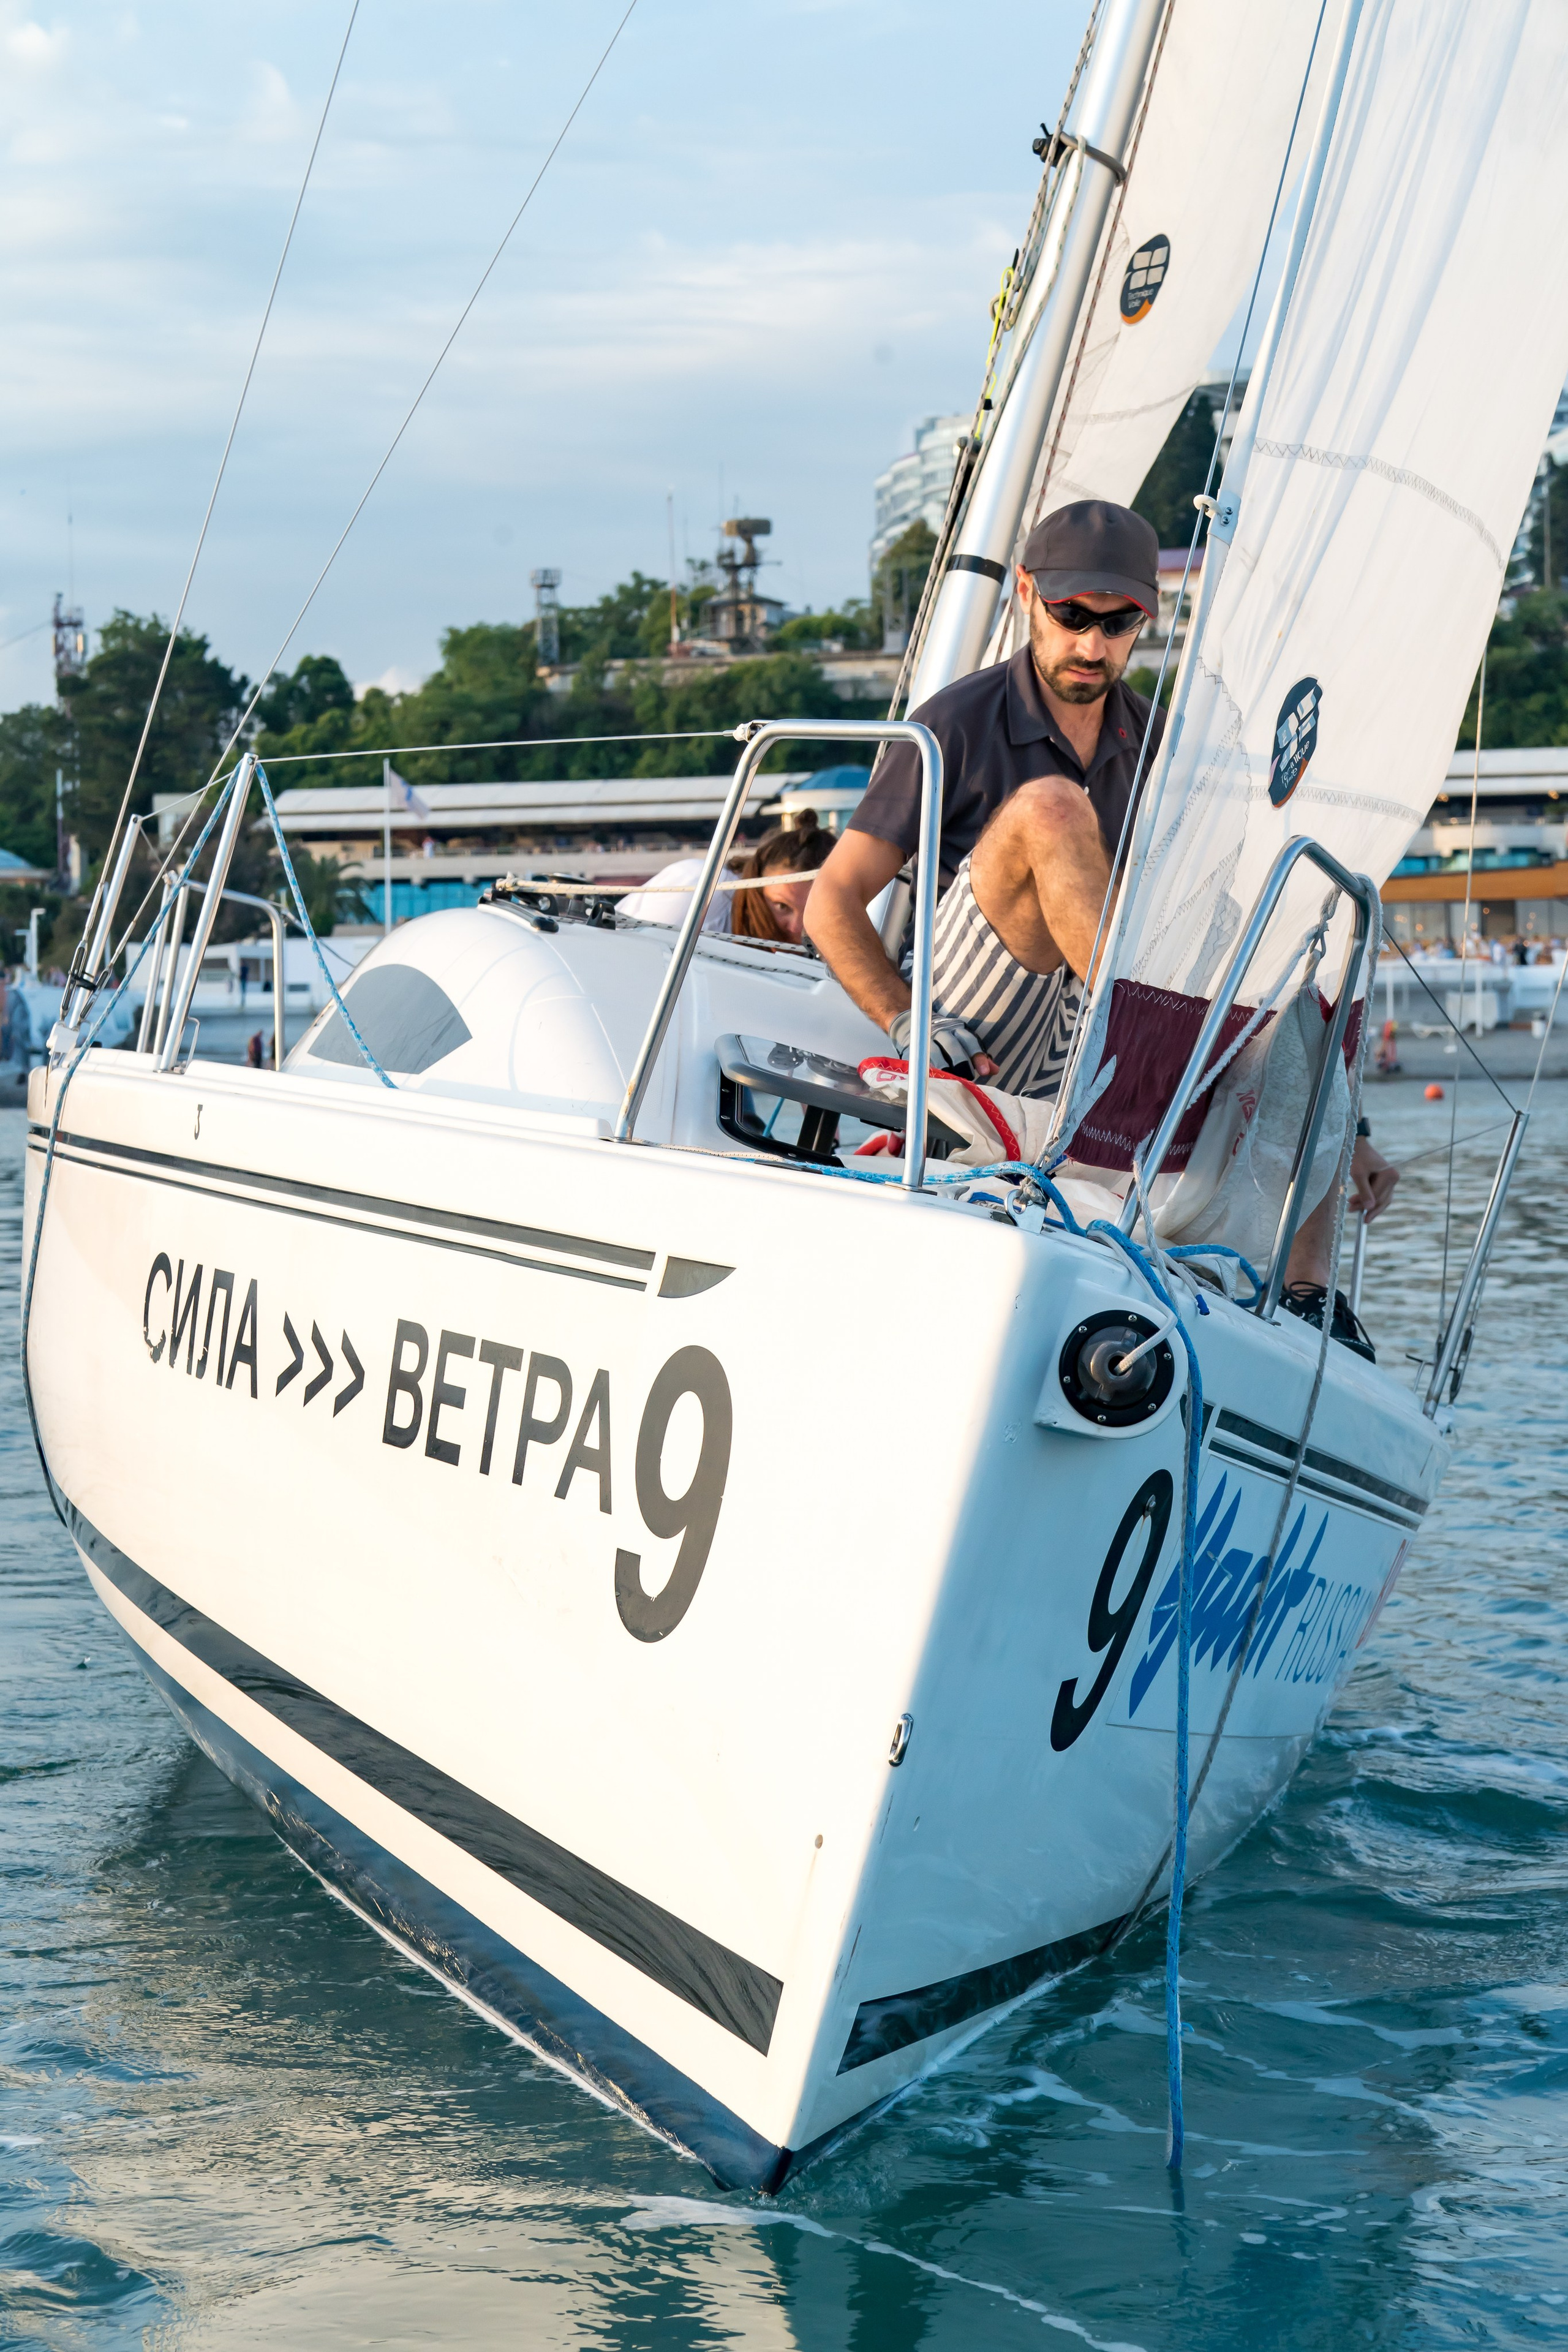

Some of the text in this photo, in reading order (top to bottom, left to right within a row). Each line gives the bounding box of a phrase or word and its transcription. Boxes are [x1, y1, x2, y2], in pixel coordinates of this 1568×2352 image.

[143, 1253, 732, 1643] СИЛА ВЕТРА 9
[1050, 1469, 1173, 1752] 9
